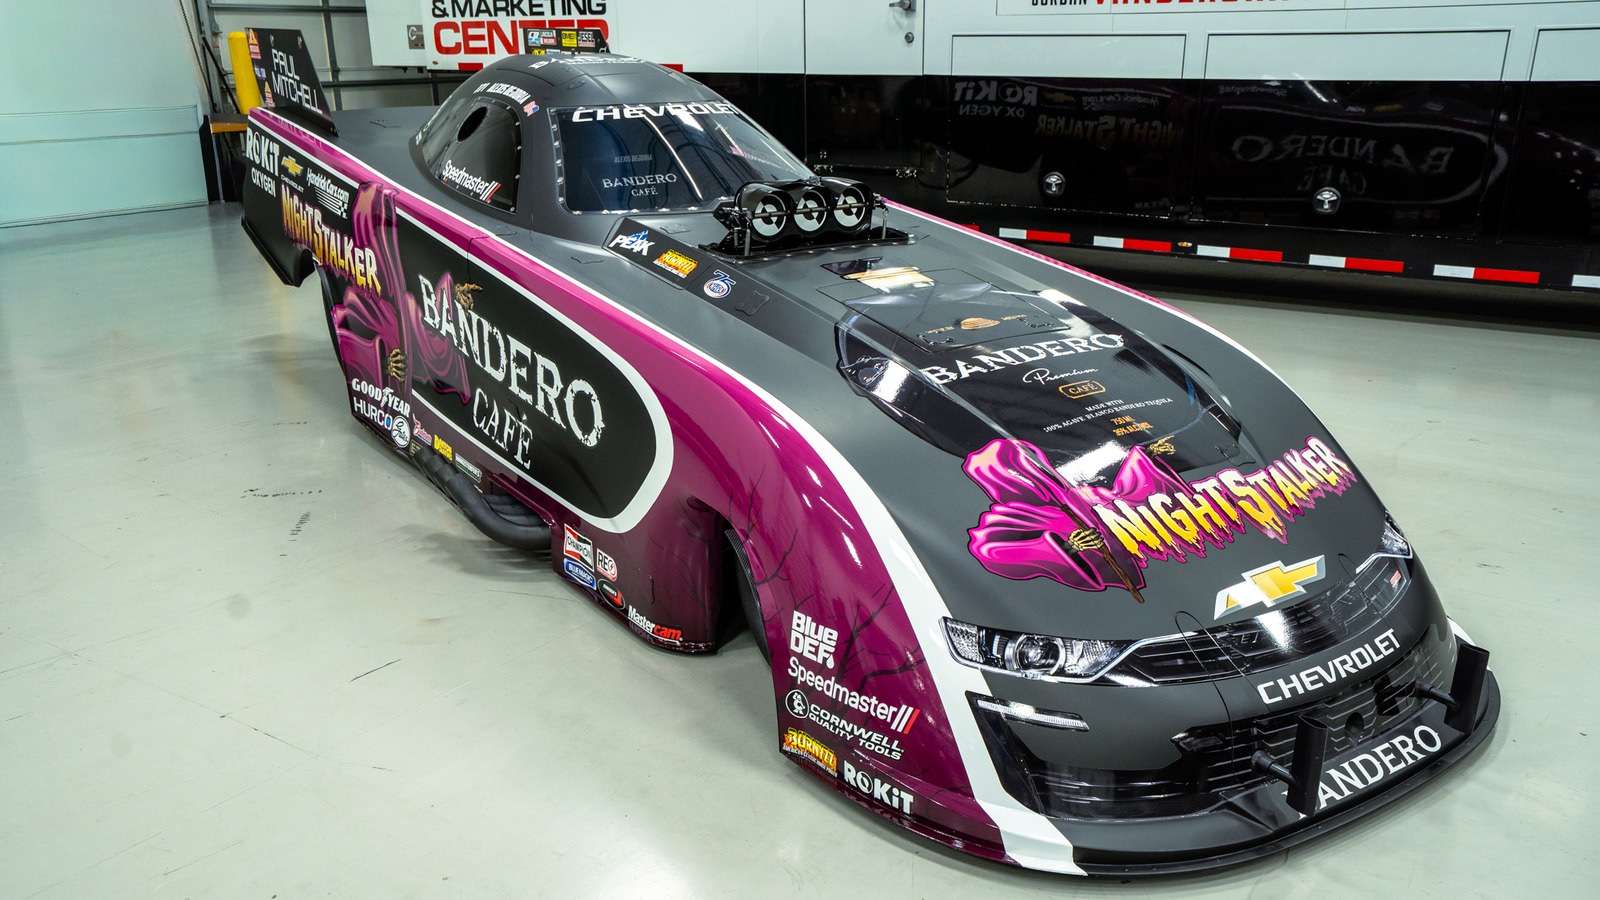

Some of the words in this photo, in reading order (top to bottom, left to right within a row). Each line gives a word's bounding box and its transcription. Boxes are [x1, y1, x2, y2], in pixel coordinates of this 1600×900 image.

[432, 0, 450, 18] &
[452, 0, 607, 17] MARKETING
[433, 19, 608, 55] CEN
[578, 32, 595, 42] JESEL
[271, 48, 300, 80] PAUL
[271, 71, 323, 115] MITCHELL
[572, 102, 739, 123] CHEVROLET
[251, 167, 277, 197] OXYGEN
[306, 168, 350, 202] HendrickCars.com
[442, 160, 489, 195] Speedmaster
[602, 173, 678, 189] BANDERO
[631, 185, 659, 197] CAFÉ
[608, 233, 656, 257] PEAK
[418, 274, 605, 447] BANDERO
[919, 333, 1126, 385] BANDERO
[1022, 367, 1099, 385] Premium
[1068, 382, 1099, 395] CAFÉ
[1084, 402, 1107, 412] MADE
[1105, 399, 1125, 407] WITH
[353, 396, 393, 431] HURCO
[1085, 408, 1115, 420] BLANCO
[1113, 401, 1146, 412] BANDERO
[1144, 397, 1174, 406] TEQUILA
[472, 388, 533, 470] CAFÉ
[627, 604, 682, 640] Mastercam
[791, 610, 839, 647] Blue
[790, 630, 836, 668] DEF
[1257, 628, 1401, 704] CHEVROLET
[787, 656, 898, 723] Speedmaster
[808, 713, 855, 741] QUALITY
[858, 738, 902, 760] TOOLS
[810, 703, 902, 751] CORNWELL
[1281, 725, 1442, 819] ANDERO
